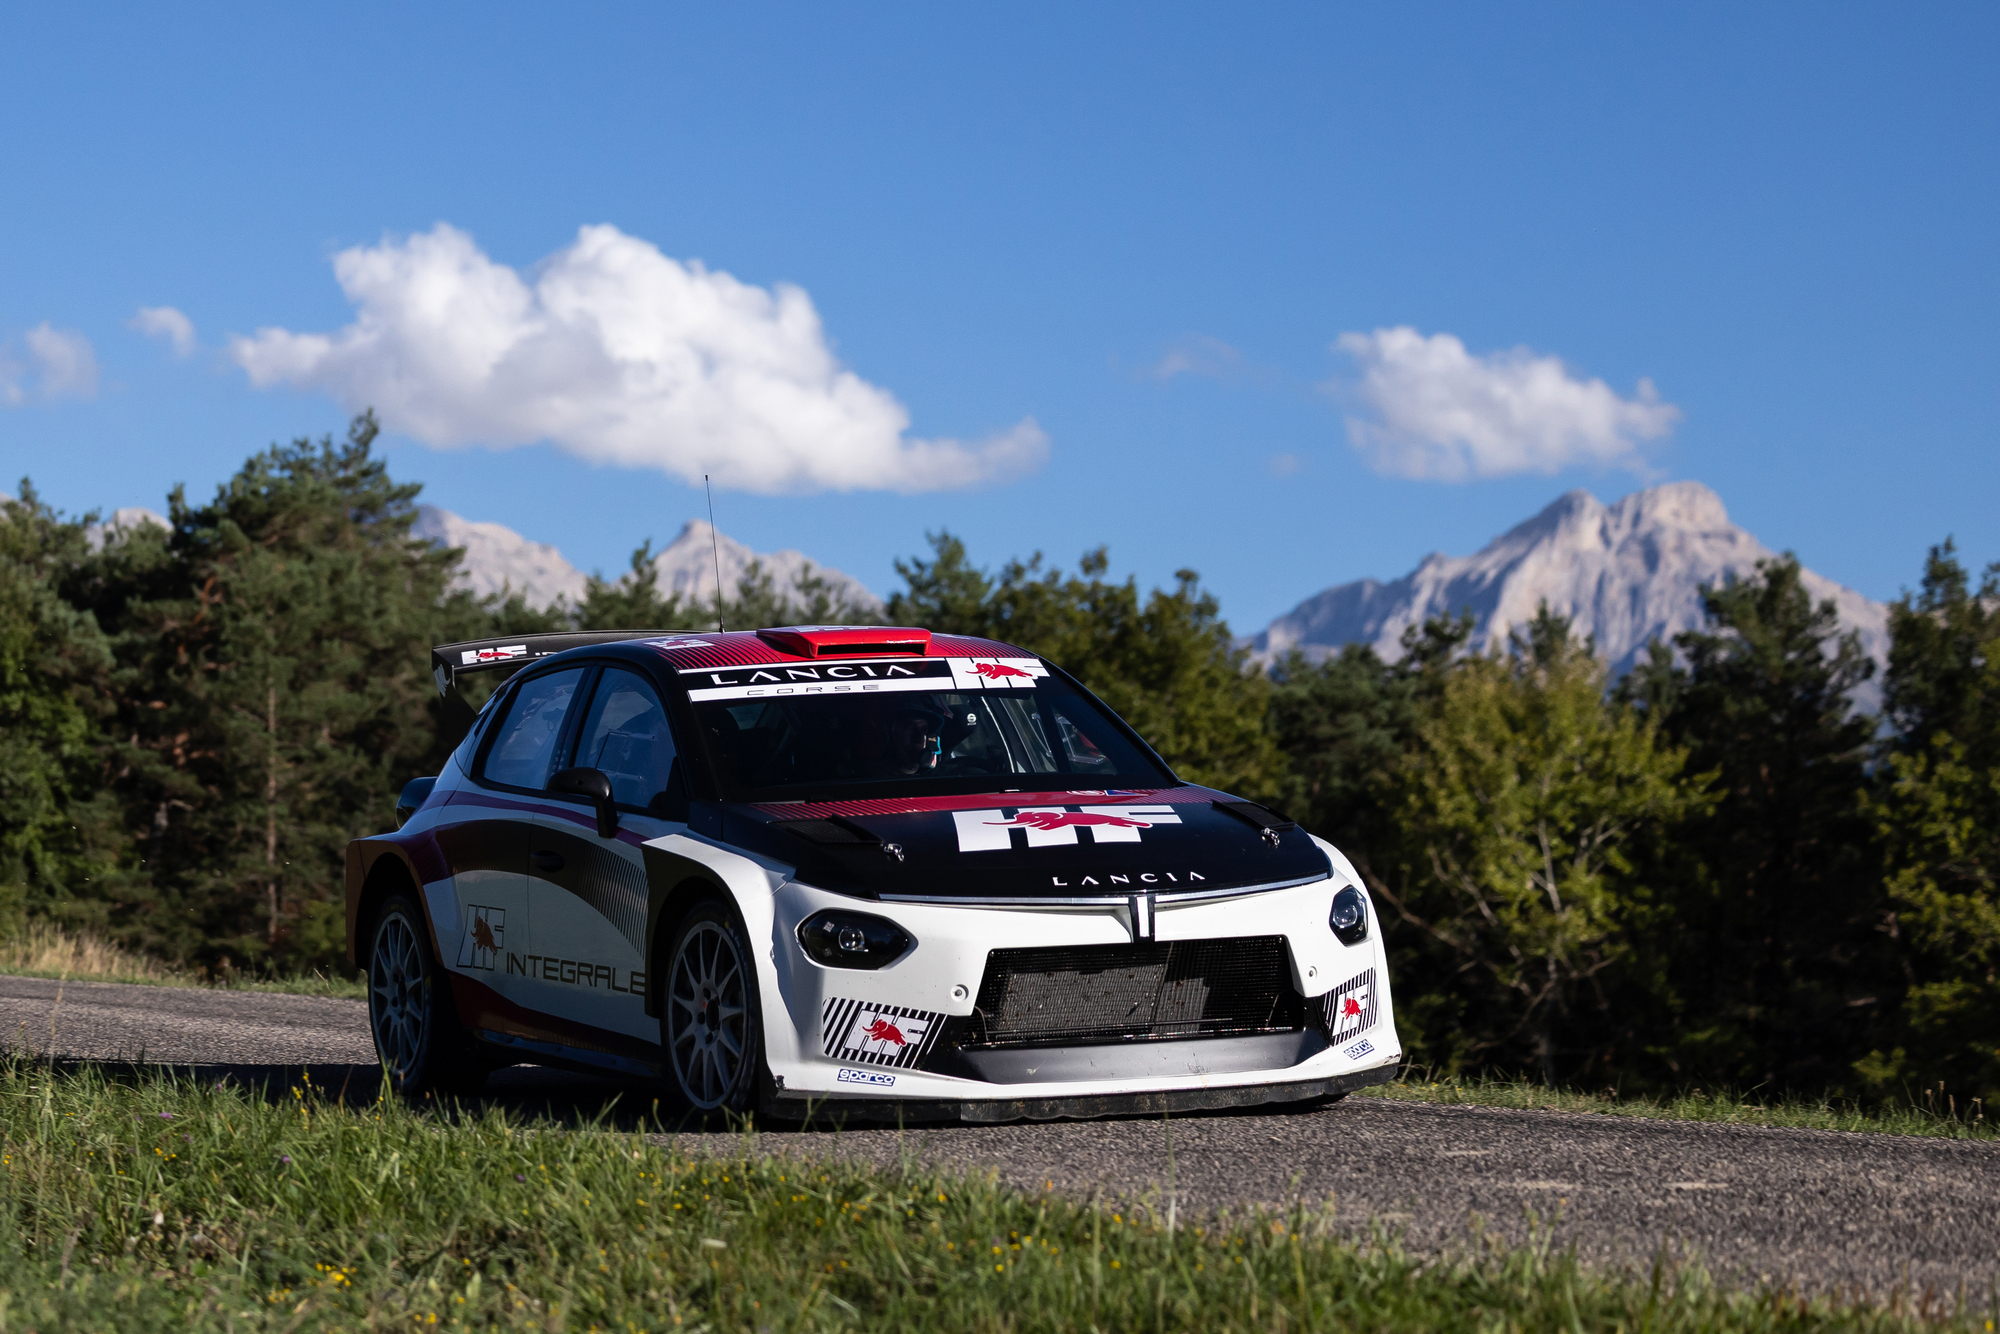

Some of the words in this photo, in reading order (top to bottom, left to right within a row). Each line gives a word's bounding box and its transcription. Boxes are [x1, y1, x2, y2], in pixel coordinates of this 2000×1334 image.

[710, 664, 916, 685] LANCIA
[746, 683, 879, 696] CORSE
[1052, 871, 1206, 887] LANCIA
[506, 951, 646, 997] INTEGRALE
[838, 1069, 895, 1086] sparco
